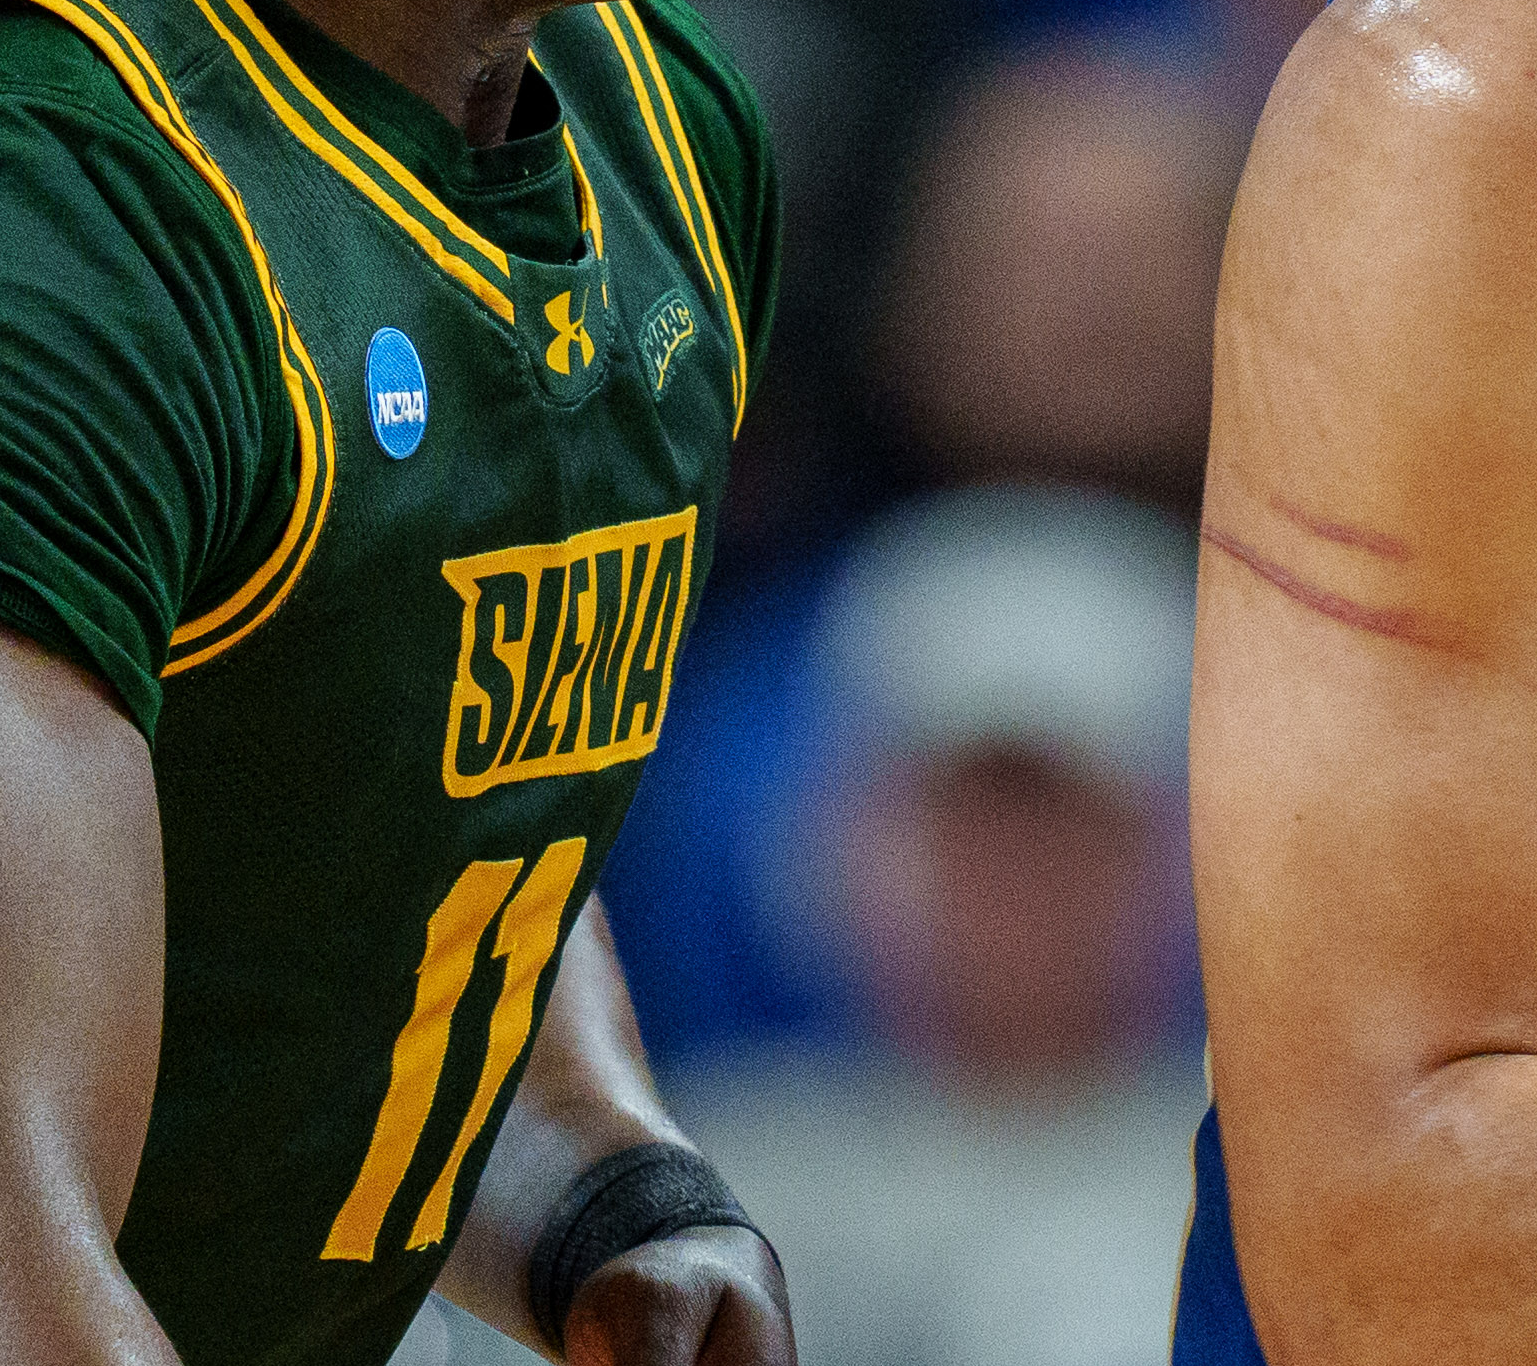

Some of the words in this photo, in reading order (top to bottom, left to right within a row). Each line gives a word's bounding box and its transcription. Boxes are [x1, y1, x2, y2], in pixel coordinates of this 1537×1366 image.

[377, 390, 425, 424] NCAA
[460, 531, 691, 776] SIENA
[320, 836, 587, 1262] 11
